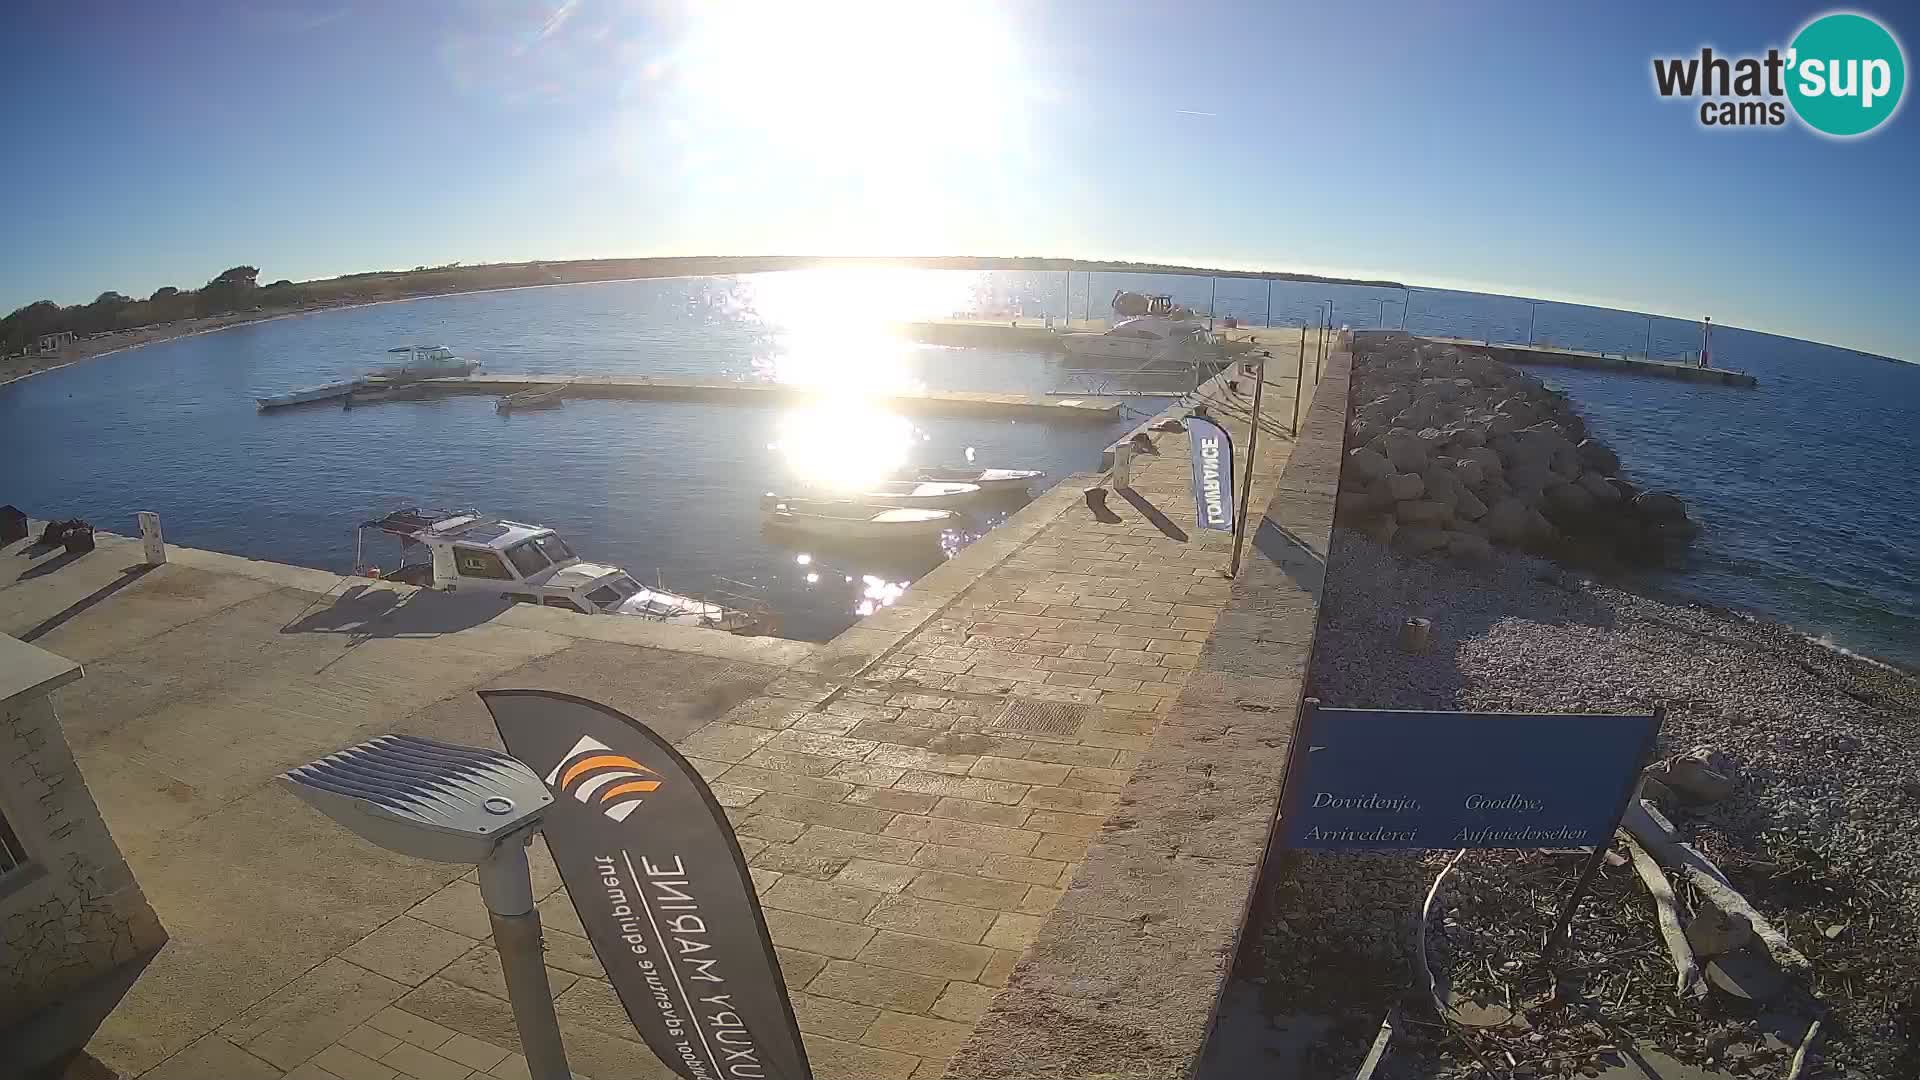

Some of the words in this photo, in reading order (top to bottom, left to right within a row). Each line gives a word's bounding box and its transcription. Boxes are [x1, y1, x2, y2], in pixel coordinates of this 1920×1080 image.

[1465, 793, 1545, 813] Goodbye,
[1304, 825, 1418, 842] Arrivederci
[1452, 824, 1589, 844] Aufwiedersehen
